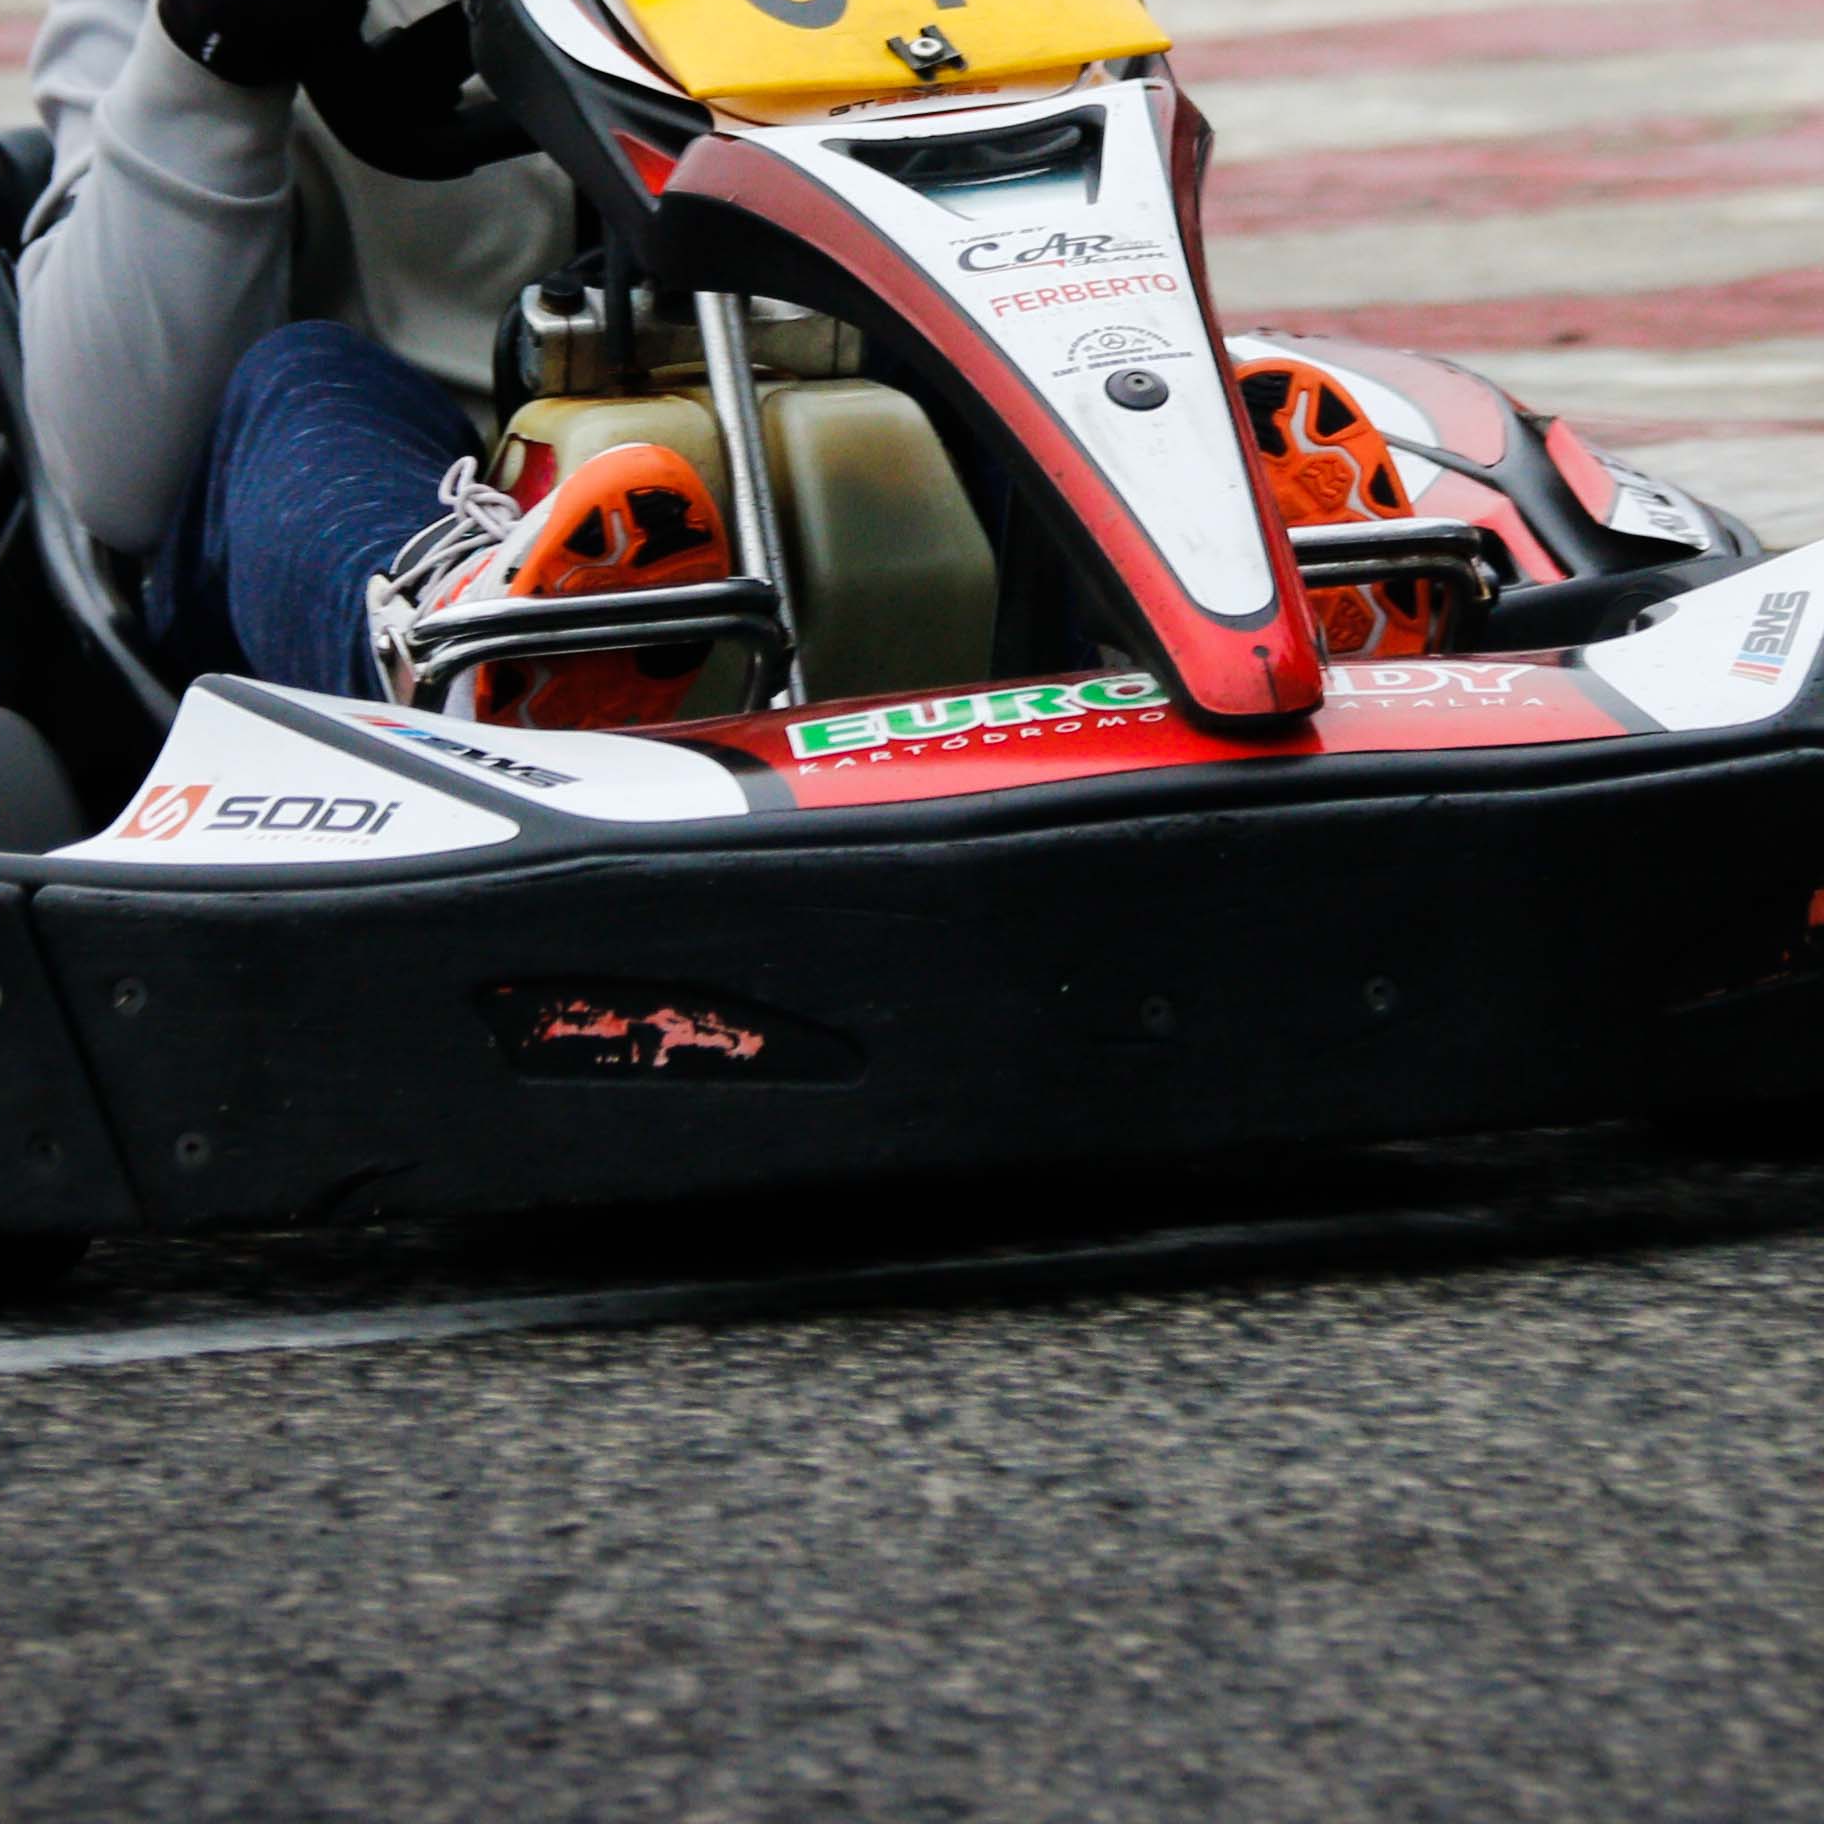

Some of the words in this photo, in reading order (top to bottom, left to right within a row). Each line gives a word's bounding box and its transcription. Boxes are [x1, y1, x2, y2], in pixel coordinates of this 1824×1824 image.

[989, 273, 1179, 318] FERBERTO
[798, 711, 1167, 776] KARTÓDROMO
[1338, 696, 1545, 710] ATALHA
